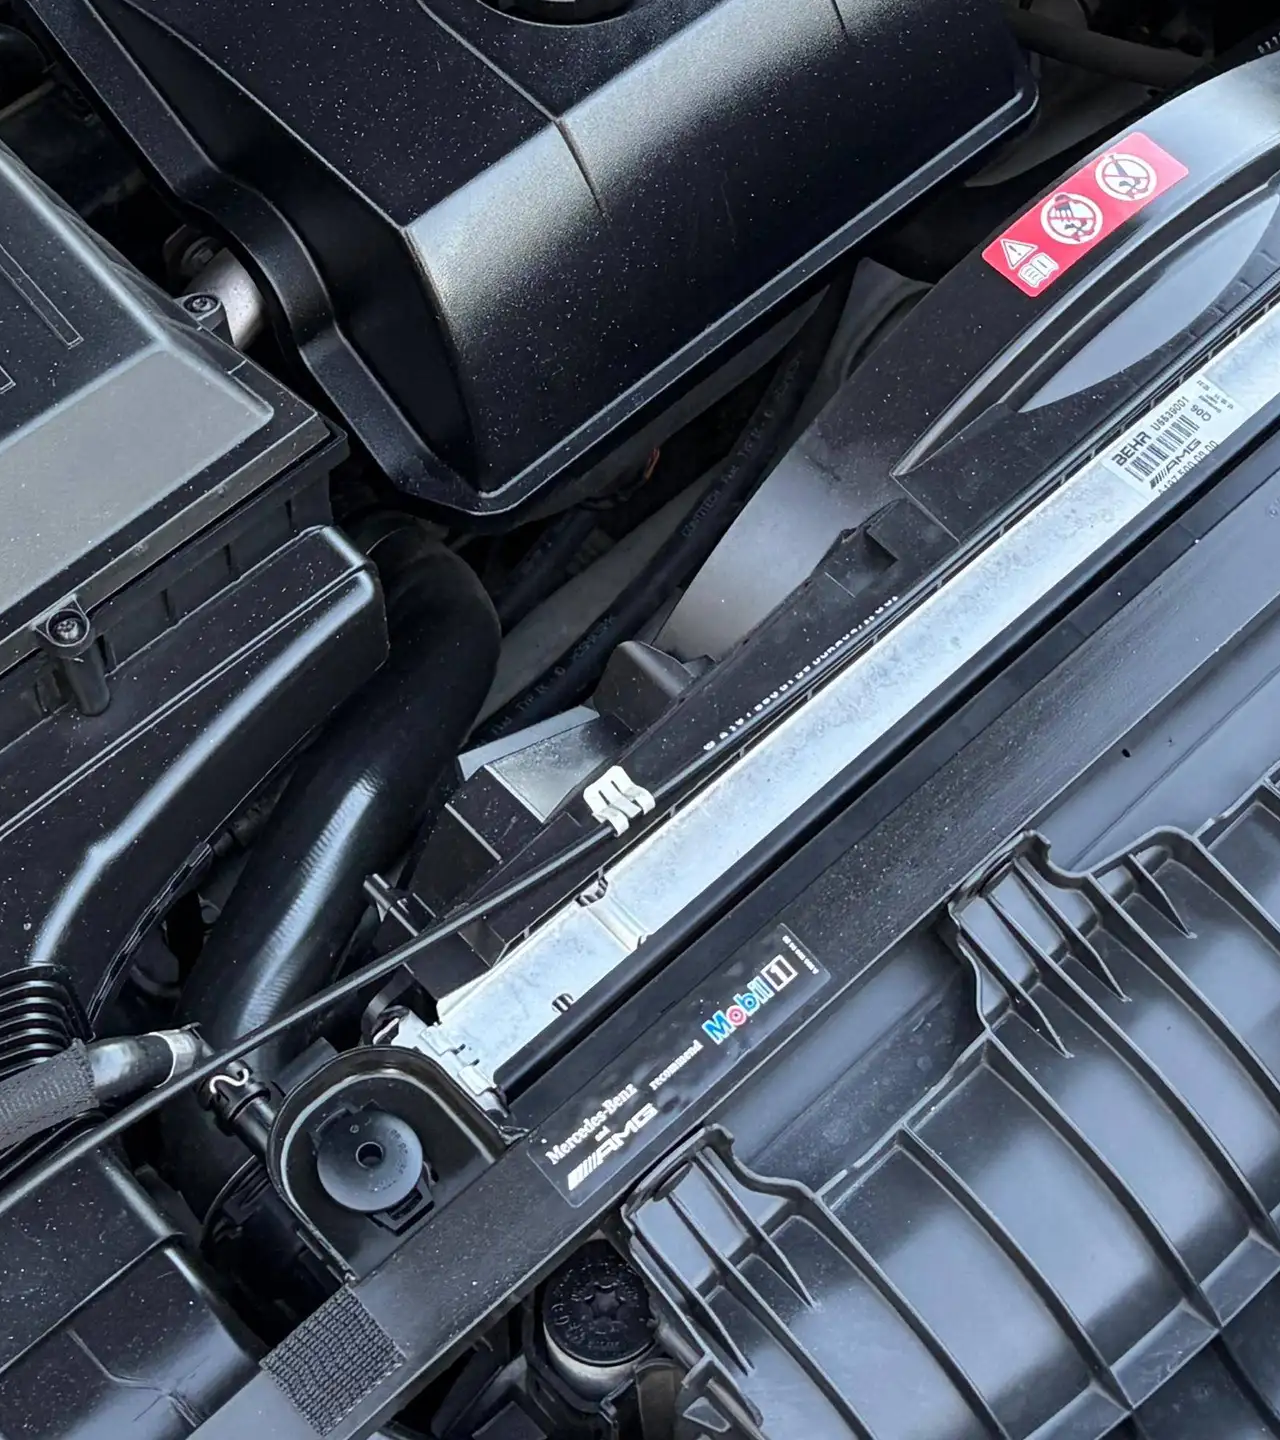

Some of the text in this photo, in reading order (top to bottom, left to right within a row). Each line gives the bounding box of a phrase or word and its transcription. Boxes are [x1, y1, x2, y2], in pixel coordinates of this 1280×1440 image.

[1111, 431, 1152, 467] BEHR
[1166, 438, 1202, 474] AMG
[545, 1083, 638, 1165] Mercedes-Benz
[649, 1039, 704, 1091] recommend
[702, 975, 775, 1045] Mobil
[595, 1126, 611, 1142] and
